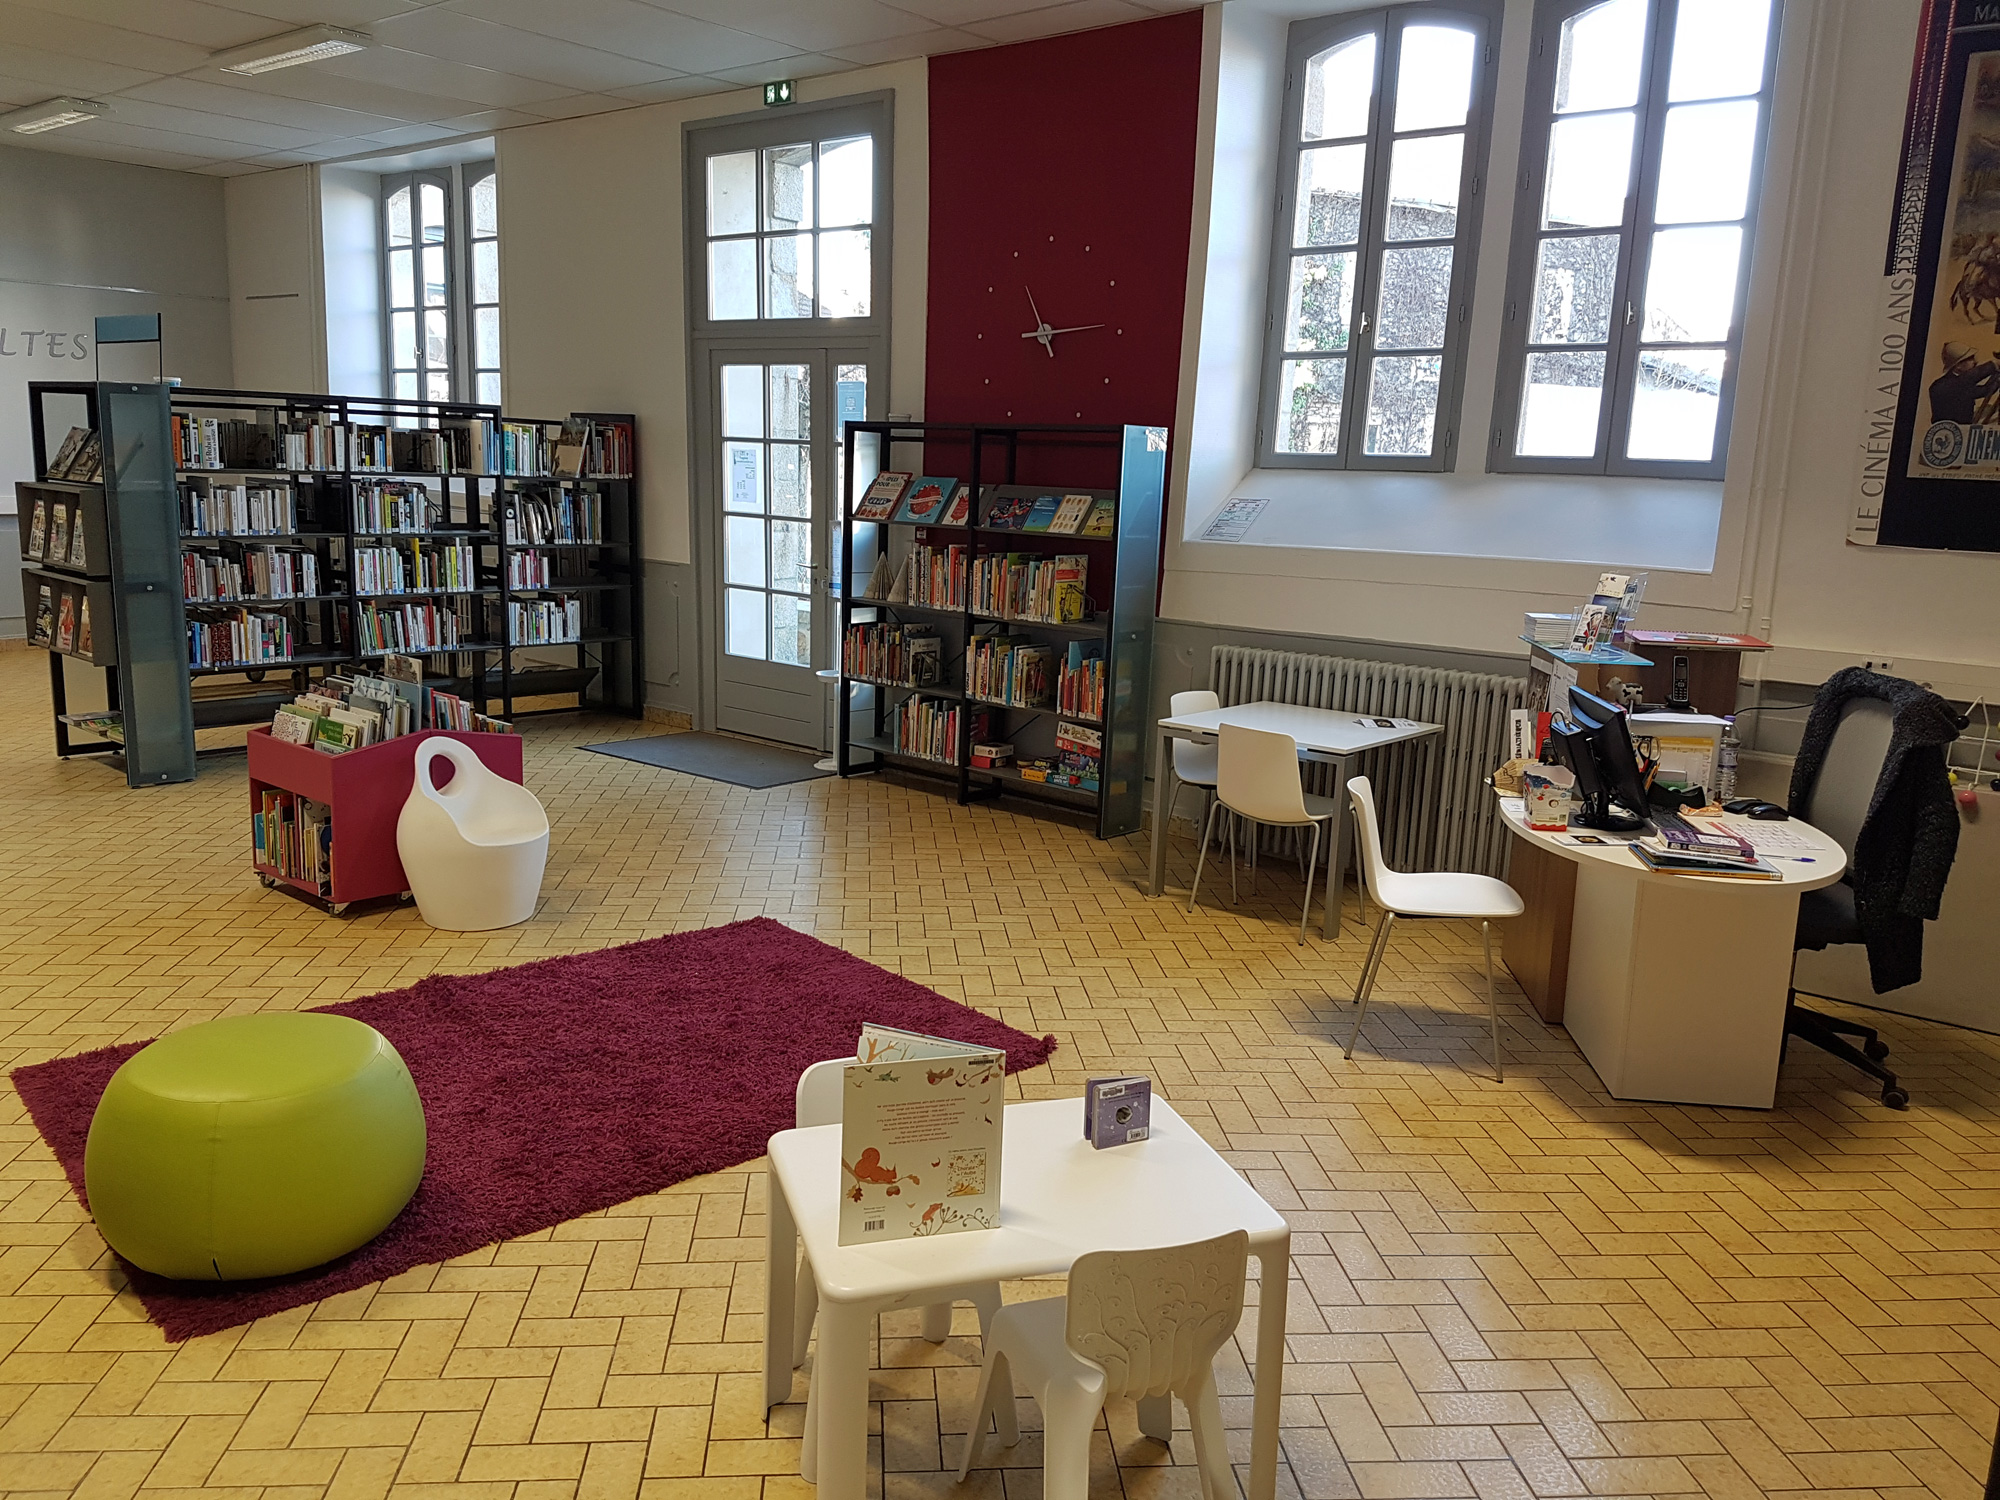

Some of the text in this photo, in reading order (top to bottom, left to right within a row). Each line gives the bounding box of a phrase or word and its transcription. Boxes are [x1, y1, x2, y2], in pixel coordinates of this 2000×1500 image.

[1855, 277, 1915, 532] LE CINÉMA A 100 ANS
